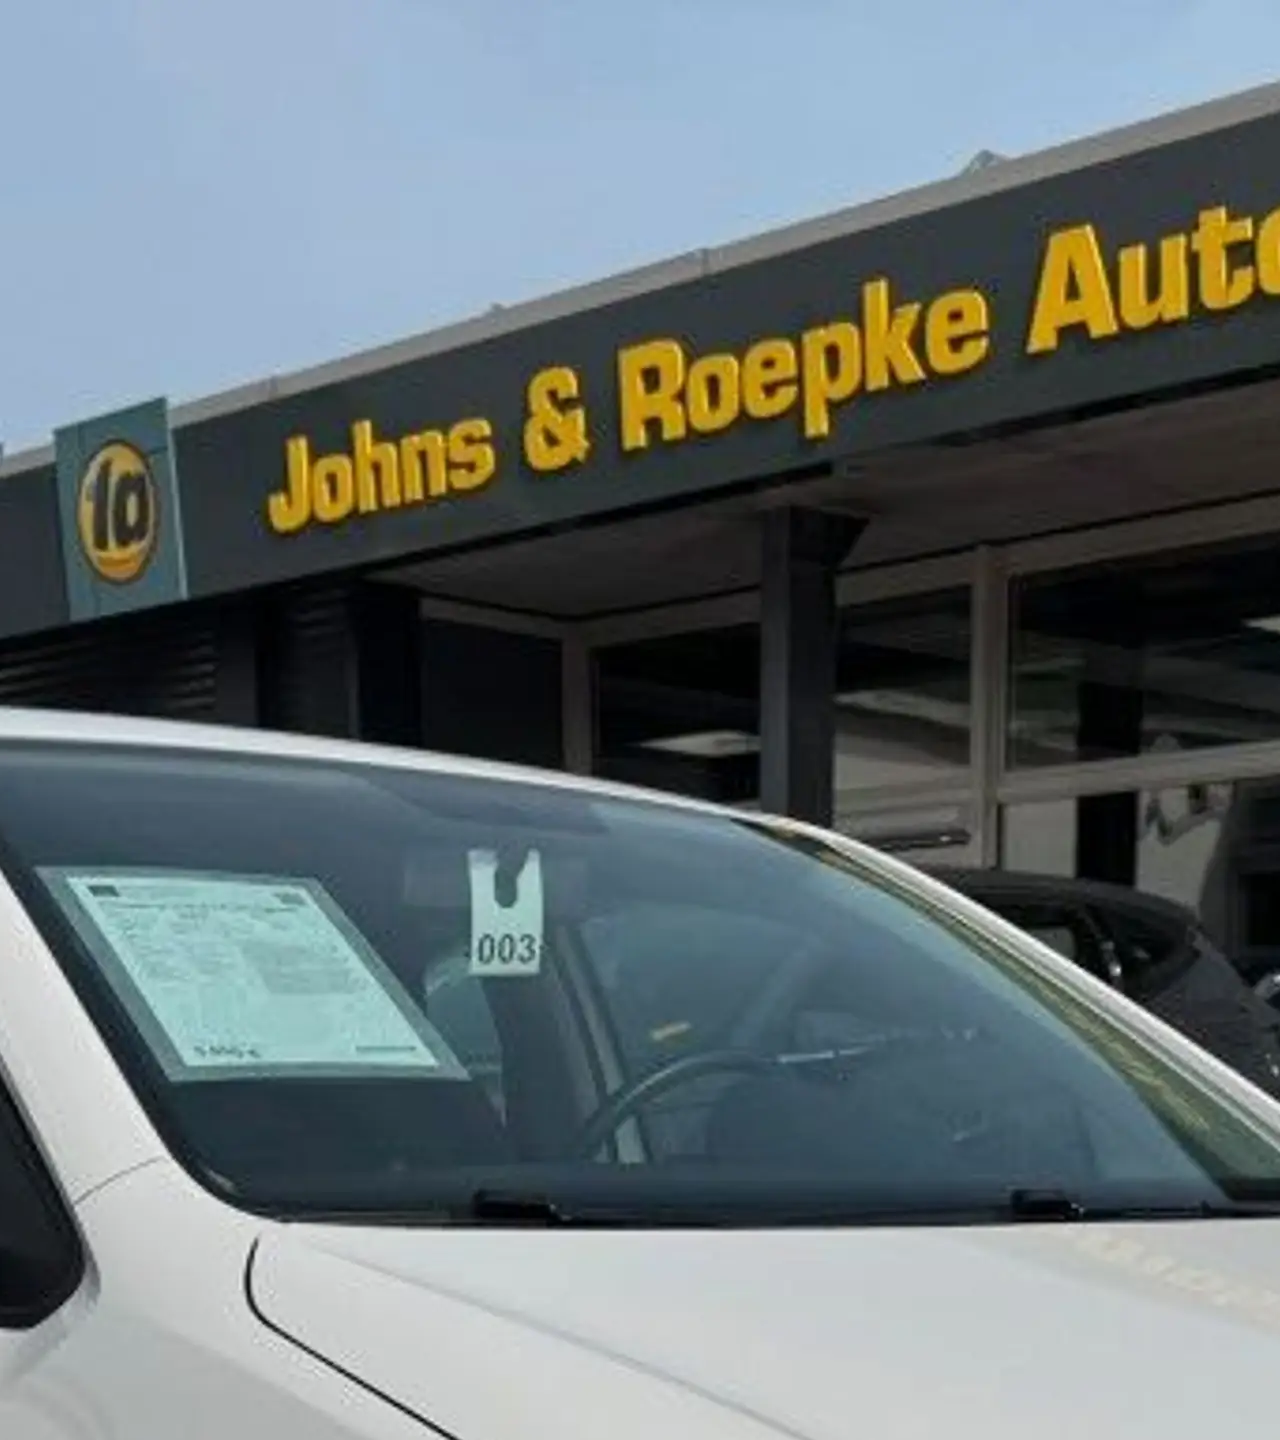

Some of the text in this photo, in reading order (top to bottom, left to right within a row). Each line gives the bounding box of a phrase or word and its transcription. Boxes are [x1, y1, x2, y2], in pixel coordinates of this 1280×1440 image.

[268, 419, 496, 531] Johns
[523, 366, 590, 470] &
[618, 280, 990, 450] Roepke
[477, 933, 537, 966] 003
